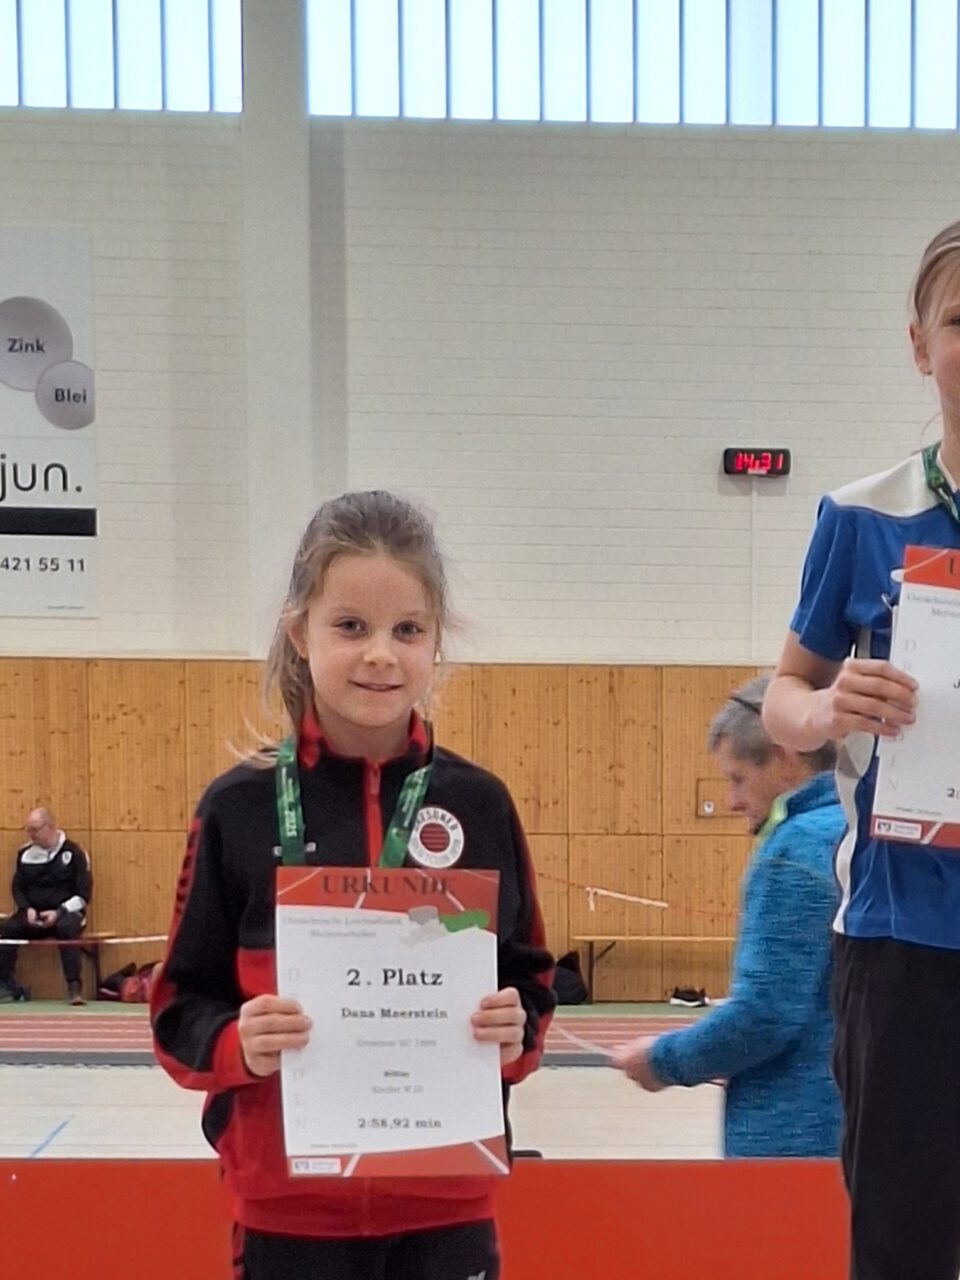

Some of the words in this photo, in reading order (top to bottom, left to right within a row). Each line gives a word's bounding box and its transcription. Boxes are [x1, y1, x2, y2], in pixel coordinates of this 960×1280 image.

[7, 338, 46, 354] Zink
[54, 388, 88, 404] Blei
[38, 556, 60, 573] 55
[67, 558, 85, 573] 11
[322, 875, 456, 895] URKUNDE
[346, 968, 372, 986] 2.
[382, 968, 443, 986] Platz
[341, 1008, 375, 1019] Dana
[380, 1008, 448, 1019] Meerstein
[415, 1117, 442, 1129] min
